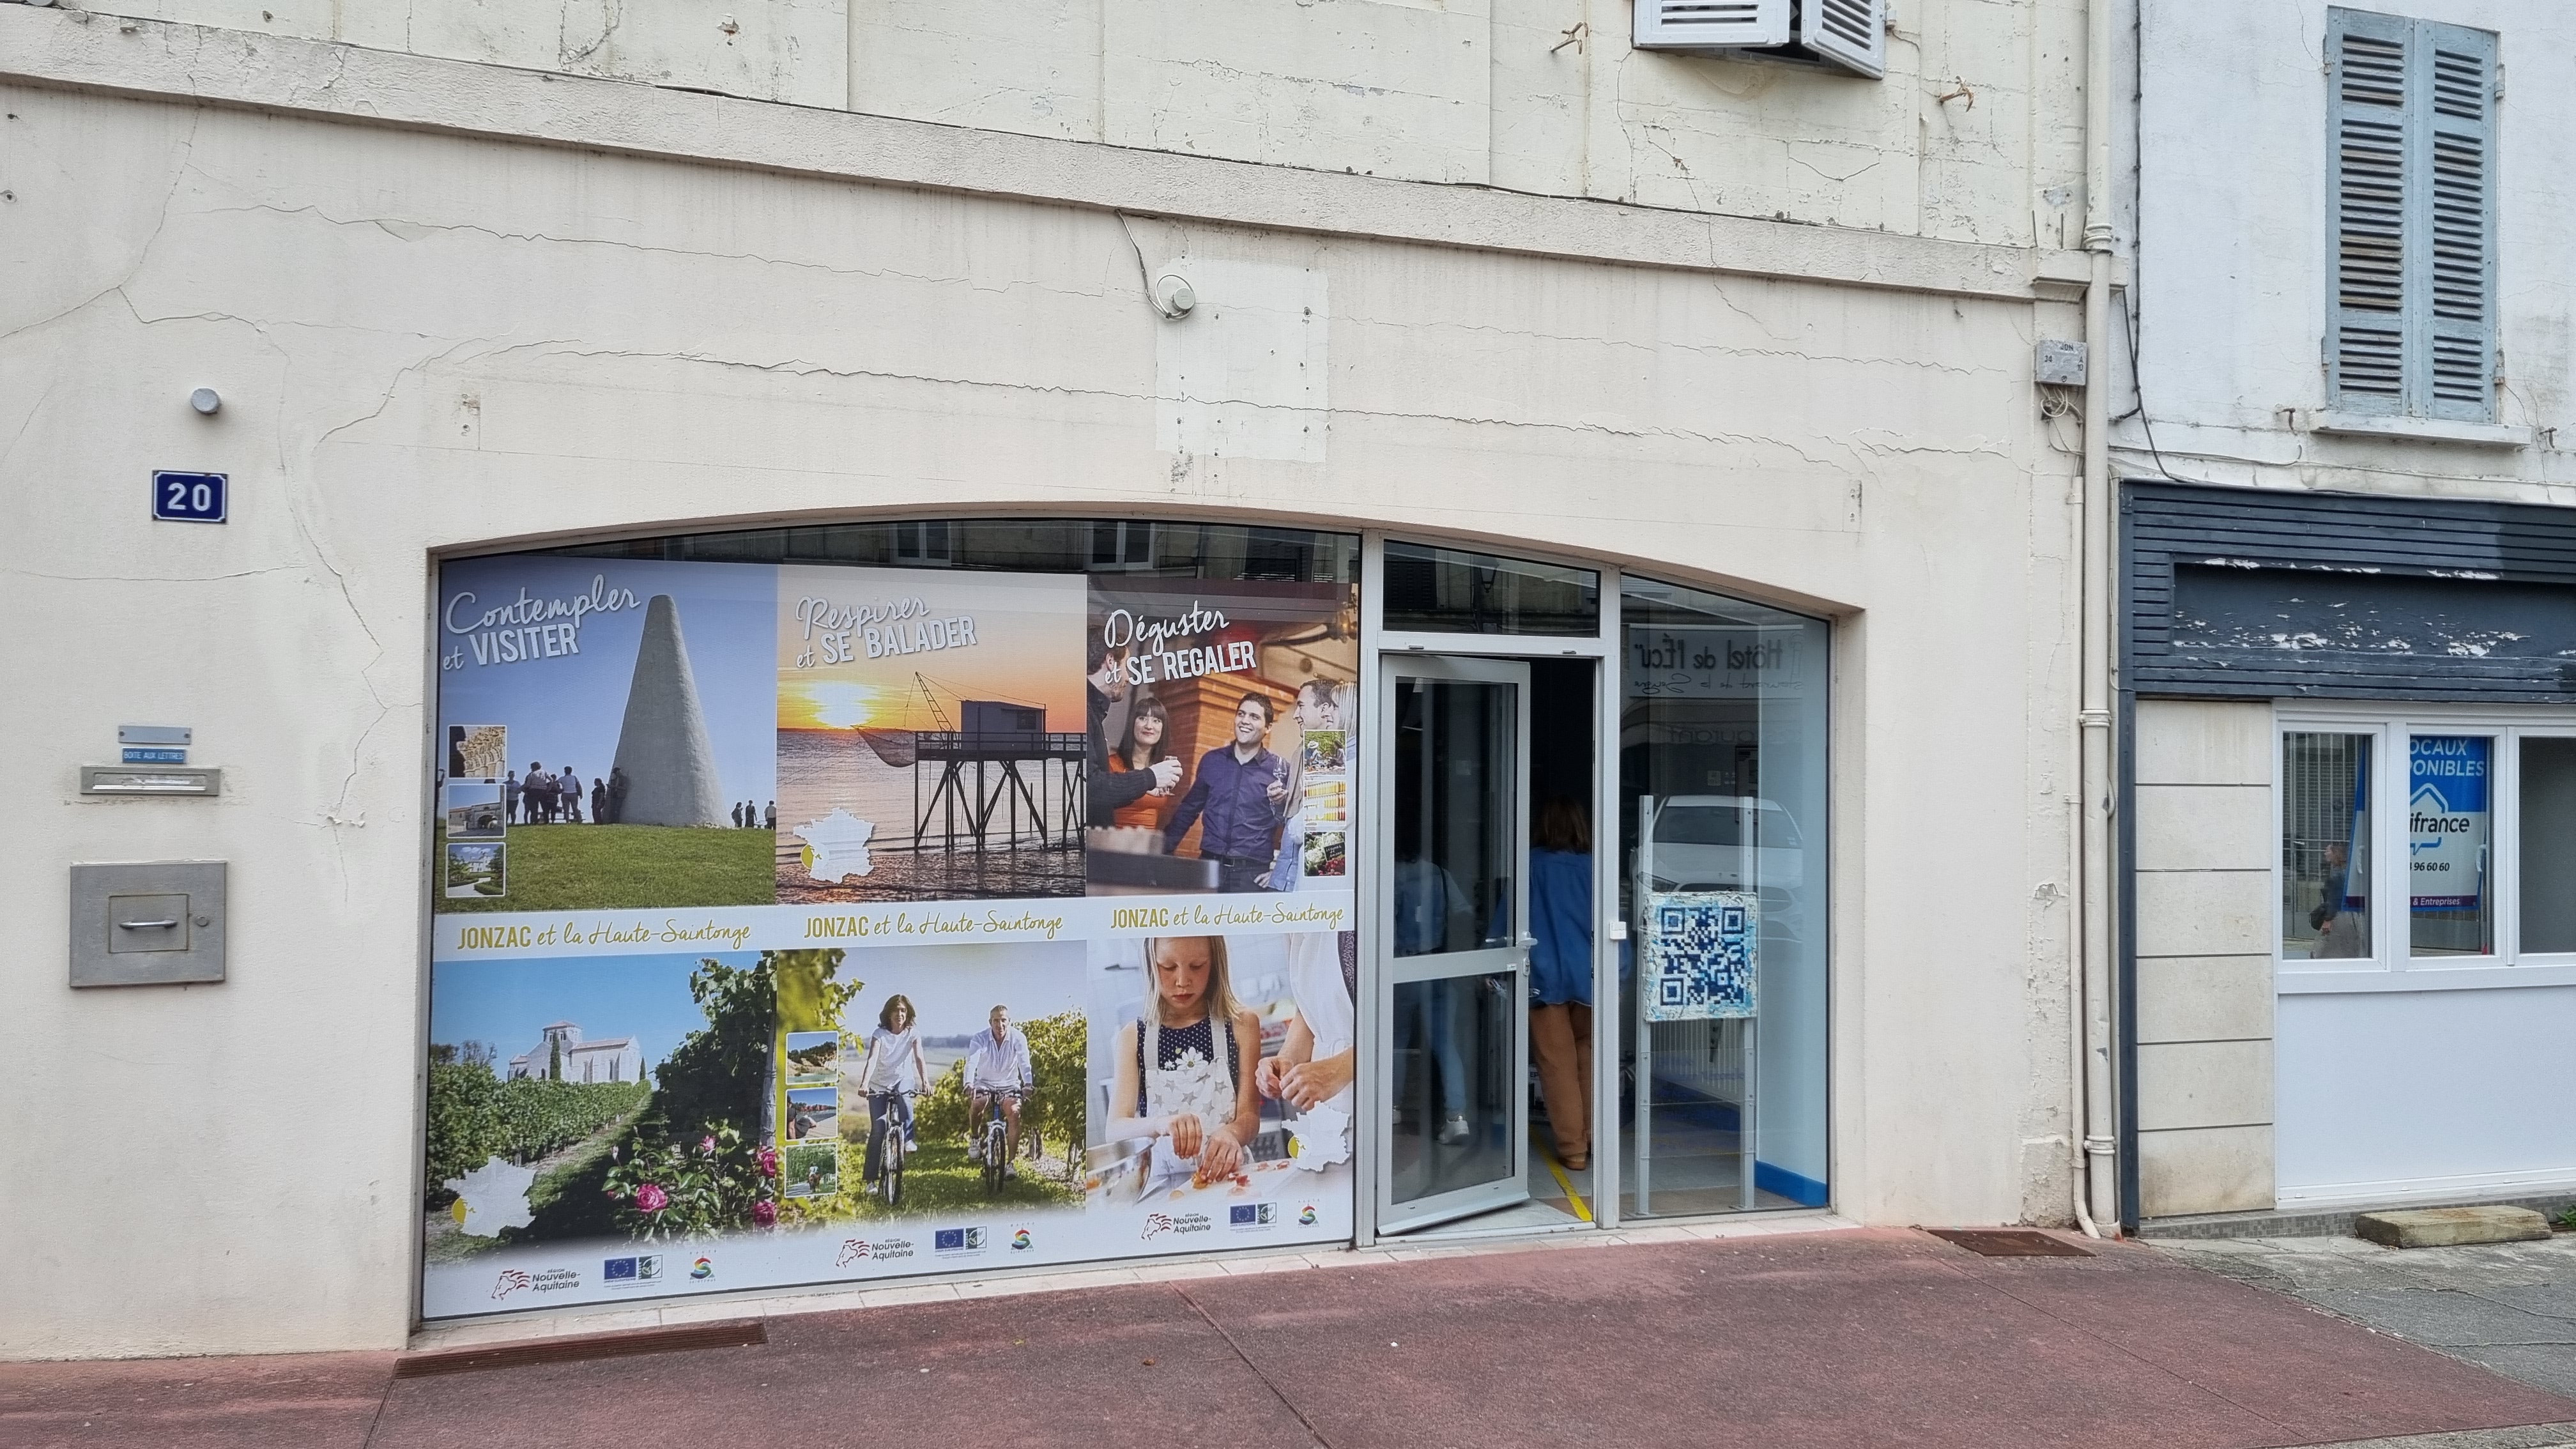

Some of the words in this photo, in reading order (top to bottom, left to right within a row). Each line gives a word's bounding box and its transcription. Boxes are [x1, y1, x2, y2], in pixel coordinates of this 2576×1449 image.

[167, 482, 211, 511] 20
[446, 574, 640, 634] Contempler
[795, 596, 930, 640] Respirer
[796, 645, 815, 668] et
[820, 631, 854, 664] SE
[864, 615, 976, 659] BALADER
[1104, 599, 1229, 657] Déguster
[443, 646, 464, 670] et
[469, 623, 579, 665] VISITER
[1105, 661, 1121, 684] et
[1126, 654, 1155, 686] SE
[1163, 641, 1256, 680] REGALER
[158, 751, 184, 760] LETTRES
[2414, 862, 2425, 871] 96
[2427, 862, 2437, 871] 60
[2439, 862, 2450, 871] 60
[1110, 907, 1169, 929] JONZAC
[1172, 907, 1189, 926] et
[1193, 905, 1209, 925] la
[1213, 901, 1344, 930] Haute-Saintonge
[2421, 897, 2460, 907] Entreprises
[457, 926, 531, 950] JONZAC
[537, 924, 556, 946] et
[564, 924, 583, 944] la
[588, 919, 751, 950] Haute-Saintonge
[804, 916, 870, 939] JONZAC
[873, 914, 892, 935] et
[897, 913, 915, 933] la
[919, 909, 1063, 939] Haute-Saintonge
[1173, 1214, 1211, 1225] Nouvelle-
[1173, 1223, 1211, 1234] Aquitaine
[871, 1241, 914, 1251] Nouvelle-
[872, 1250, 914, 1262] Aquitaine
[532, 1271, 581, 1282] Nouvelle-
[532, 1280, 579, 1293] Aquitaine
